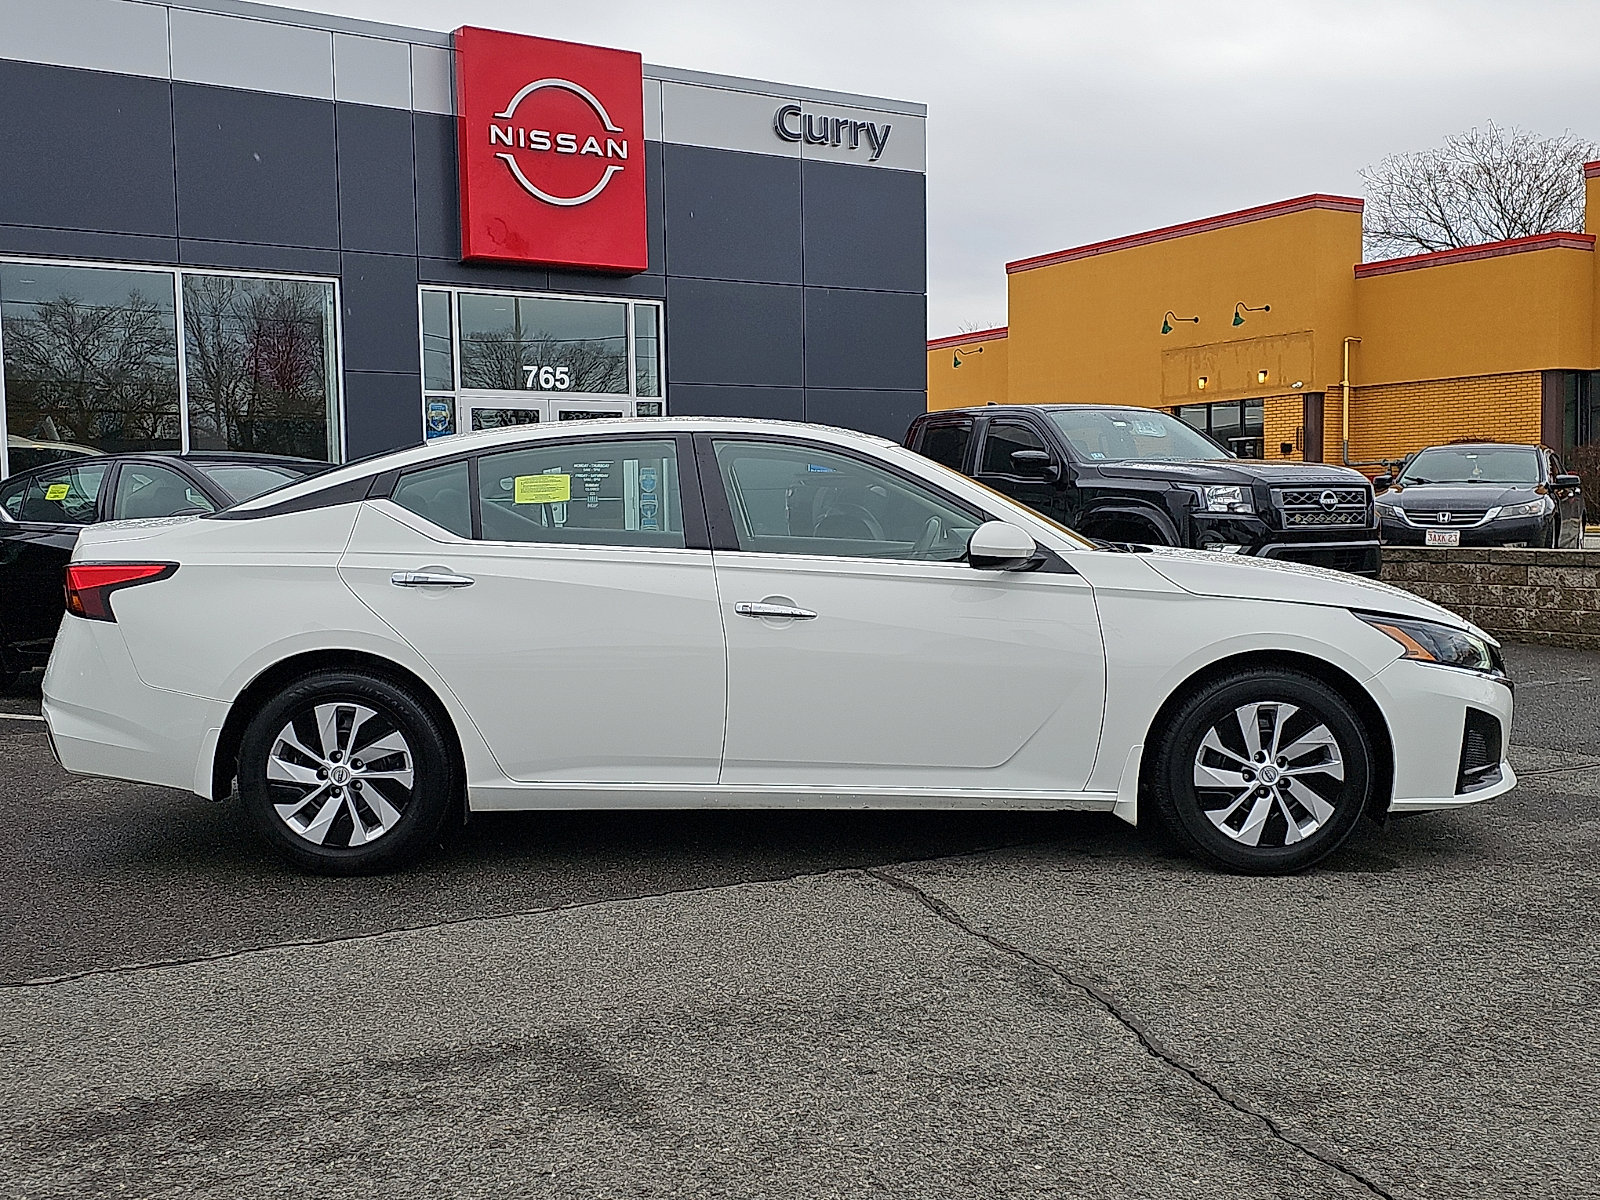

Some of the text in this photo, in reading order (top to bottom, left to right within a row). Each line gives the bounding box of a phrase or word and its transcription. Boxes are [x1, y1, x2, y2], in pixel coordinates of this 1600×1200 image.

[489, 124, 628, 159] NISSAN
[773, 104, 893, 162] Curry
[522, 365, 570, 390] 765
